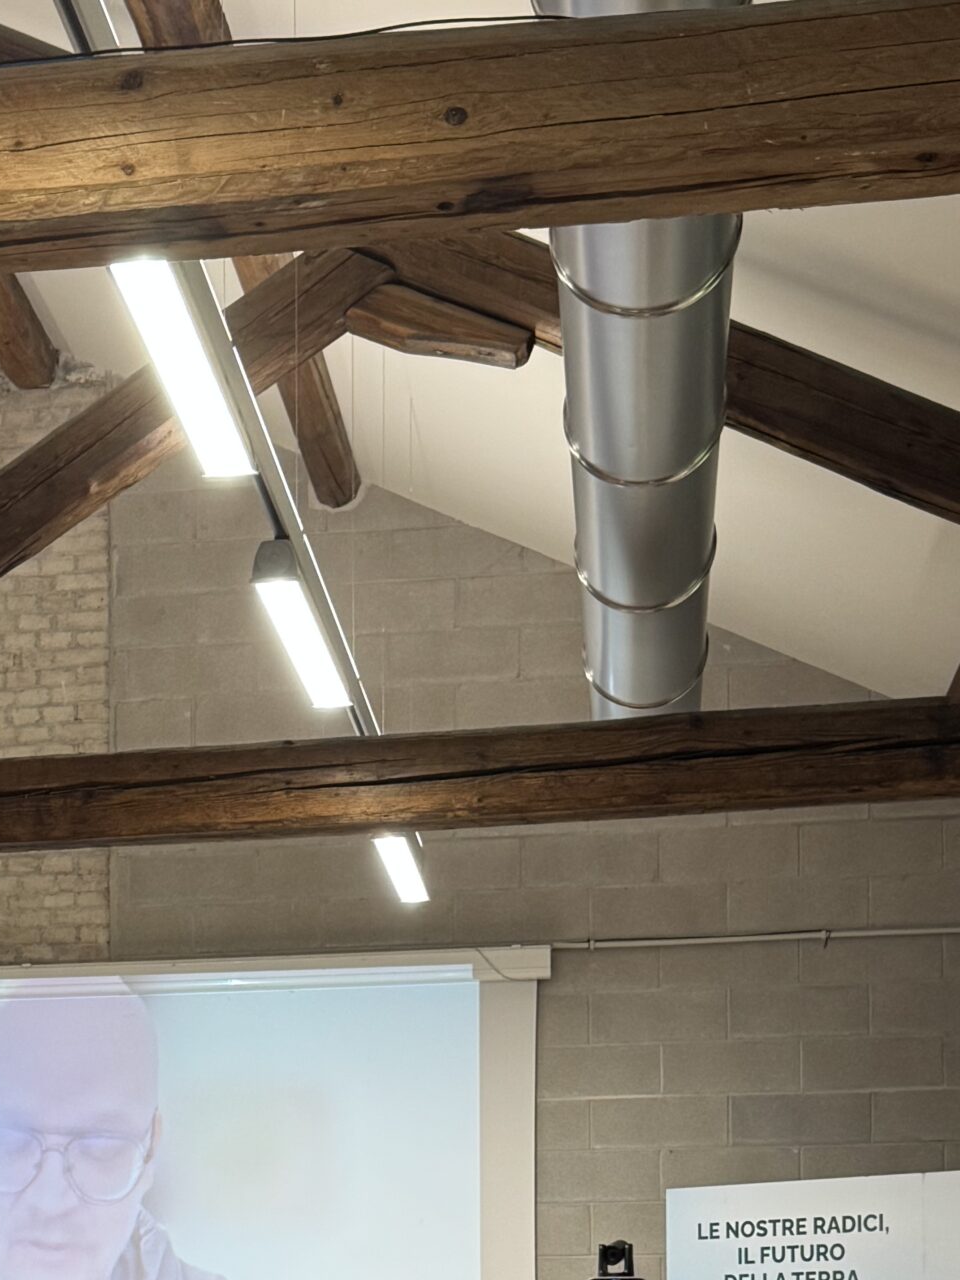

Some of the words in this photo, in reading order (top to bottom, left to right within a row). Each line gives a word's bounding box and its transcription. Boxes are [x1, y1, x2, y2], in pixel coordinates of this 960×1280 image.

[697, 1222, 720, 1240] LE
[725, 1218, 808, 1239] NOSTRE
[813, 1213, 890, 1235] RADICI,
[737, 1247, 756, 1265] IL
[760, 1243, 846, 1264] FUTURO
